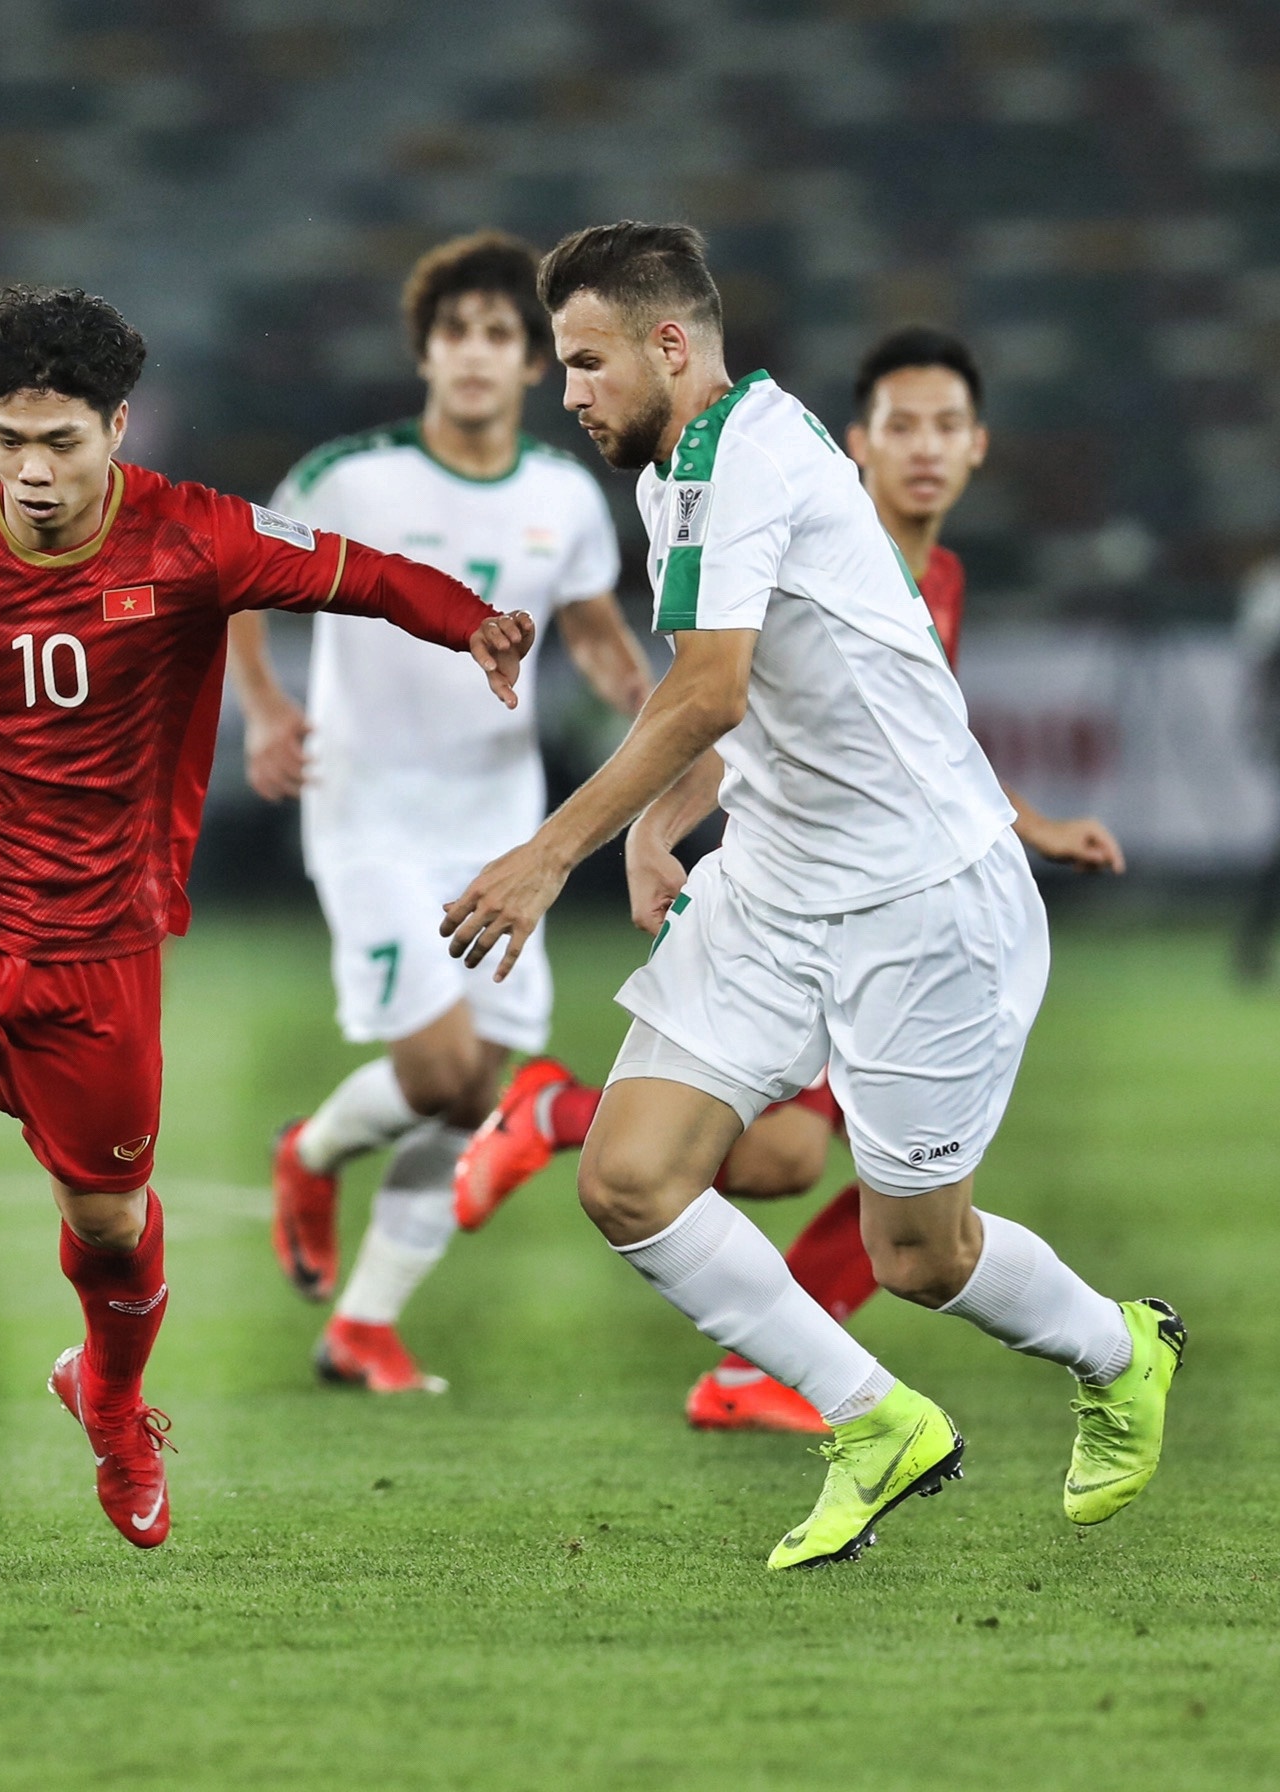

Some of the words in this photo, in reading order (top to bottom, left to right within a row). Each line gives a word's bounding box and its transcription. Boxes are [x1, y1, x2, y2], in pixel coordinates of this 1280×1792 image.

[467, 560, 499, 603] 7
[11, 632, 89, 708] 10
[368, 941, 400, 1007] 7
[928, 1141, 960, 1160] JAKO
